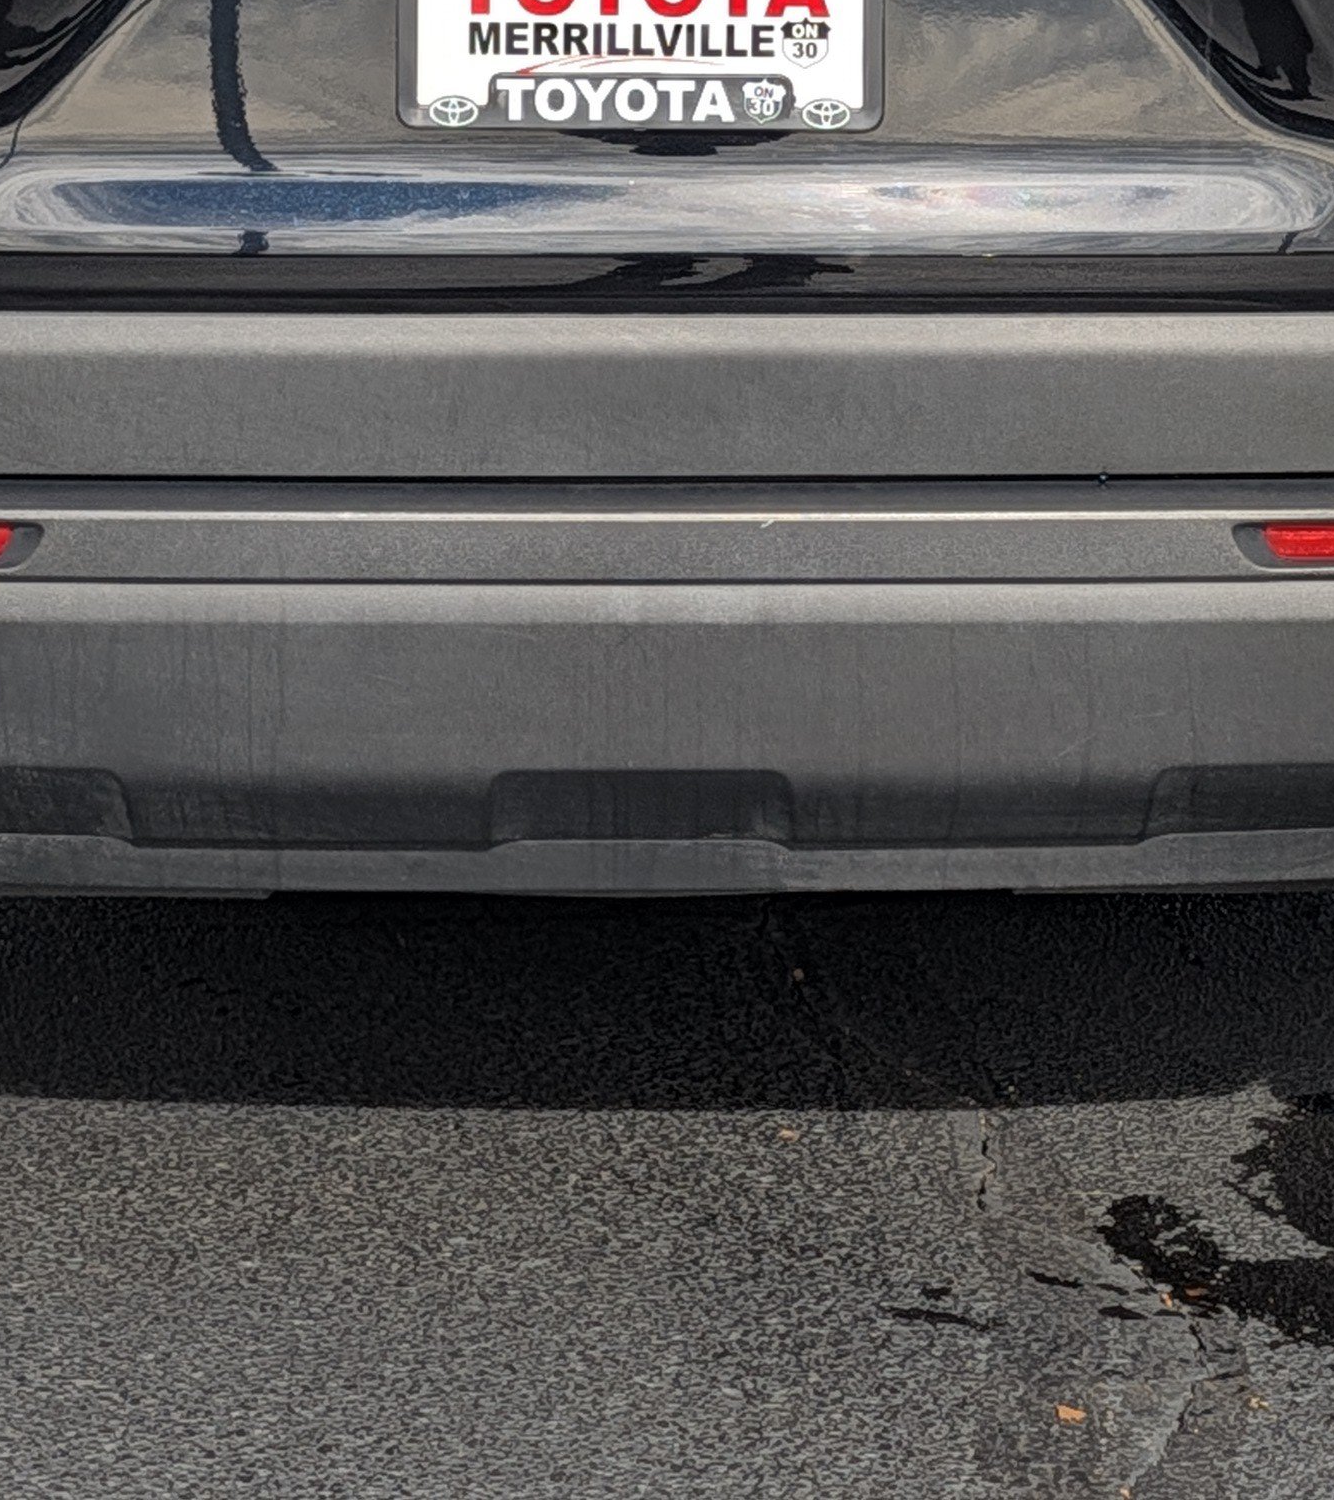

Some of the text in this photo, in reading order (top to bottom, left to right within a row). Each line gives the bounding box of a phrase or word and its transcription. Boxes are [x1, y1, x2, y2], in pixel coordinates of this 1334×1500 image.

[468, 22, 775, 57] MERRILLVILLE
[791, 23, 819, 38] ON
[792, 41, 818, 59] 30
[496, 78, 736, 122] TOYOTA
[753, 85, 774, 98] ON
[748, 98, 775, 116] 30
